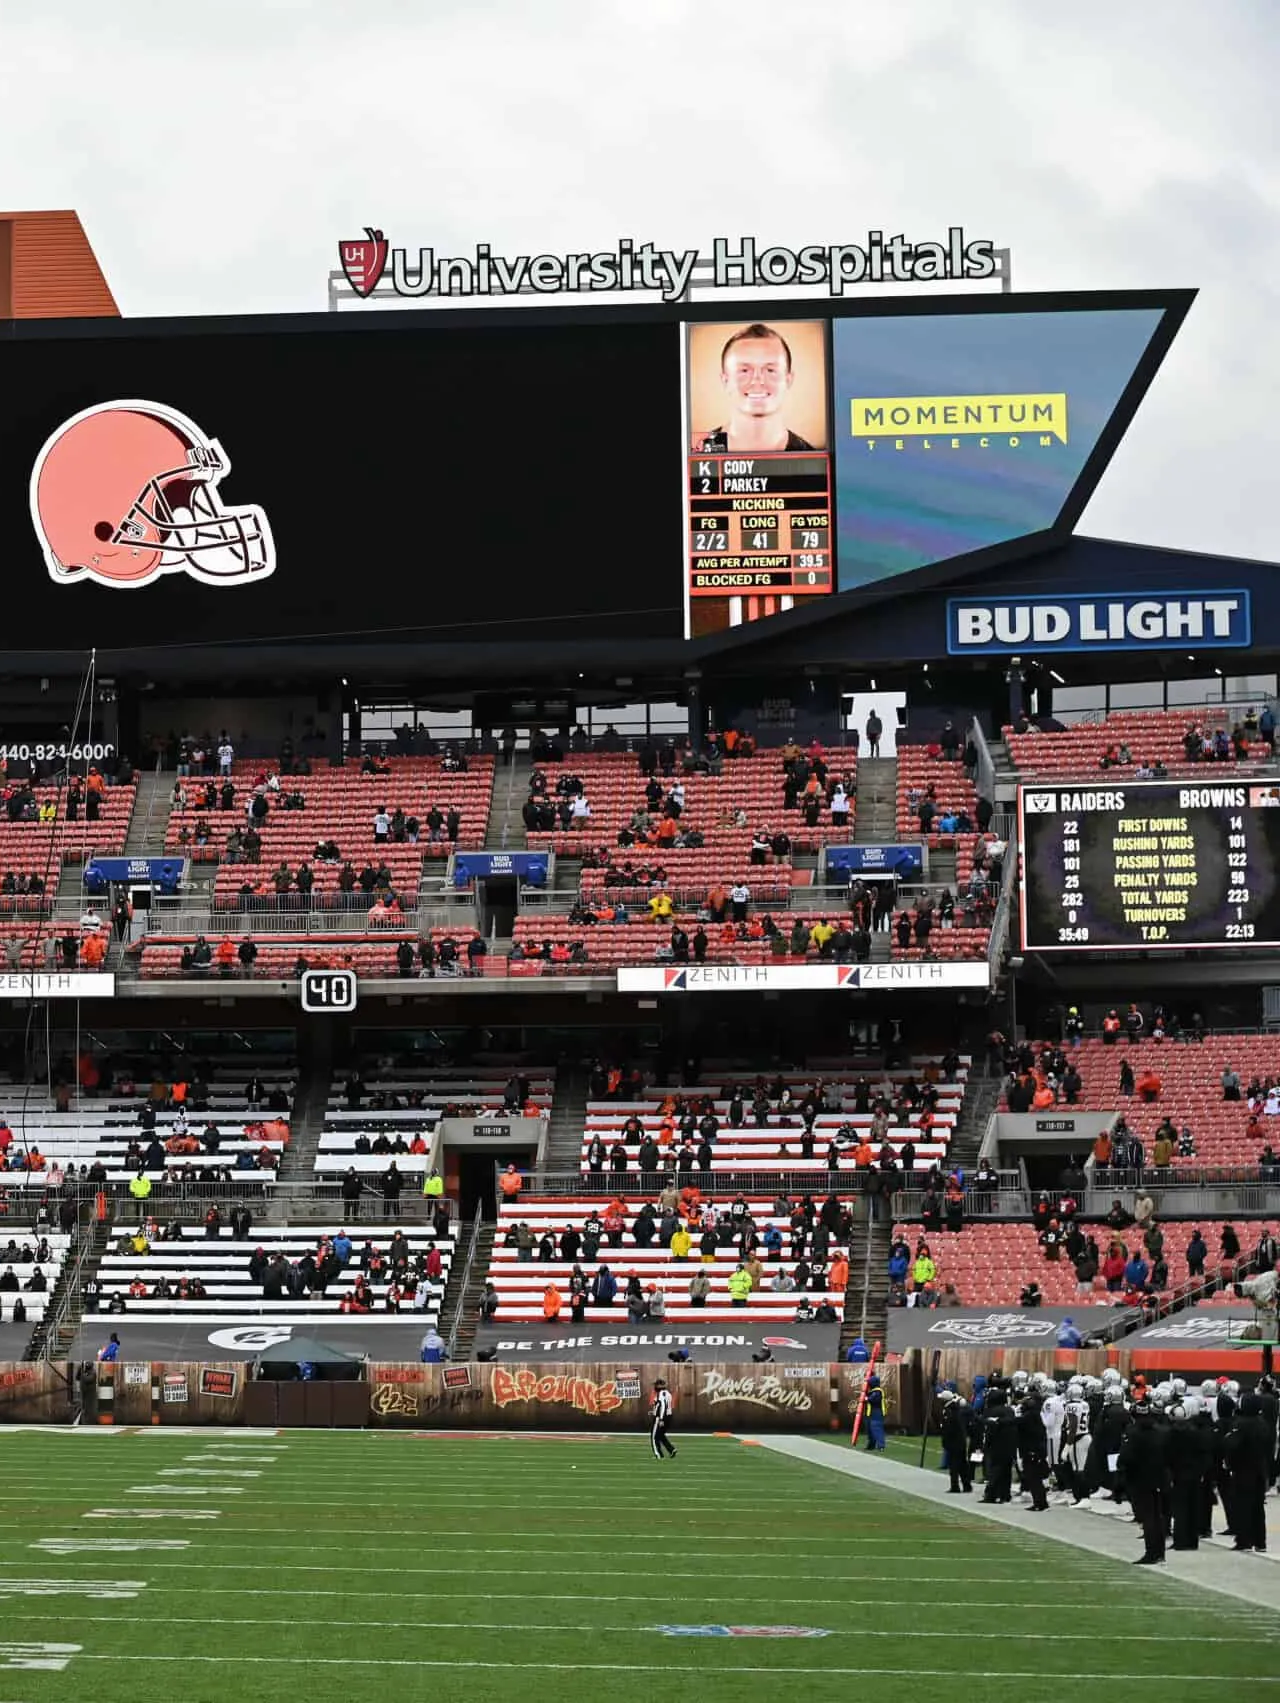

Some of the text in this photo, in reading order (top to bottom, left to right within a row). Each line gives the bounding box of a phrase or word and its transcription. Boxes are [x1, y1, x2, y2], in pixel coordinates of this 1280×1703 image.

[345, 247, 364, 261] UH
[391, 227, 996, 301] University Hospitals
[864, 403, 1053, 426] MOMENTUM
[867, 436, 1052, 450] TELECOM
[699, 461, 754, 476] K CODY
[701, 478, 768, 493] 2 PARKEY
[732, 499, 785, 511] KICKING
[701, 518, 717, 529] FG
[742, 517, 777, 528] LONG
[791, 516, 828, 527] FG YDS
[696, 533, 726, 551] 2/2
[752, 532, 768, 549] 41
[801, 532, 819, 549] 79
[697, 557, 789, 568] AVG PER ATTEMPT
[799, 555, 823, 567] 39.5
[696, 574, 771, 586] BLOCKED FG
[958, 599, 1239, 644] BUD LIGHT
[1060, 792, 1125, 811] RAIDERS
[1179, 788, 1246, 808] BROWNS
[1118, 818, 1188, 832] FIRST DOWNS
[1113, 836, 1195, 851] RUSHING YARDS
[1115, 855, 1196, 869] PASSING YARDS
[1114, 872, 1198, 888] PENALTY YARDS
[1121, 890, 1189, 905] TOTAL YARDS
[1124, 908, 1186, 923] TURNOVERS
[690, 968, 768, 982] ZENITH
[864, 965, 942, 979] ZENITH
[311, 977, 347, 1005] 40
[497, 1334, 753, 1350] BE THE SOLUTION.
[491, 1367, 623, 1416] BROWNS
[698, 1368, 756, 1397] DAWG
[760, 1374, 813, 1411] POUND
